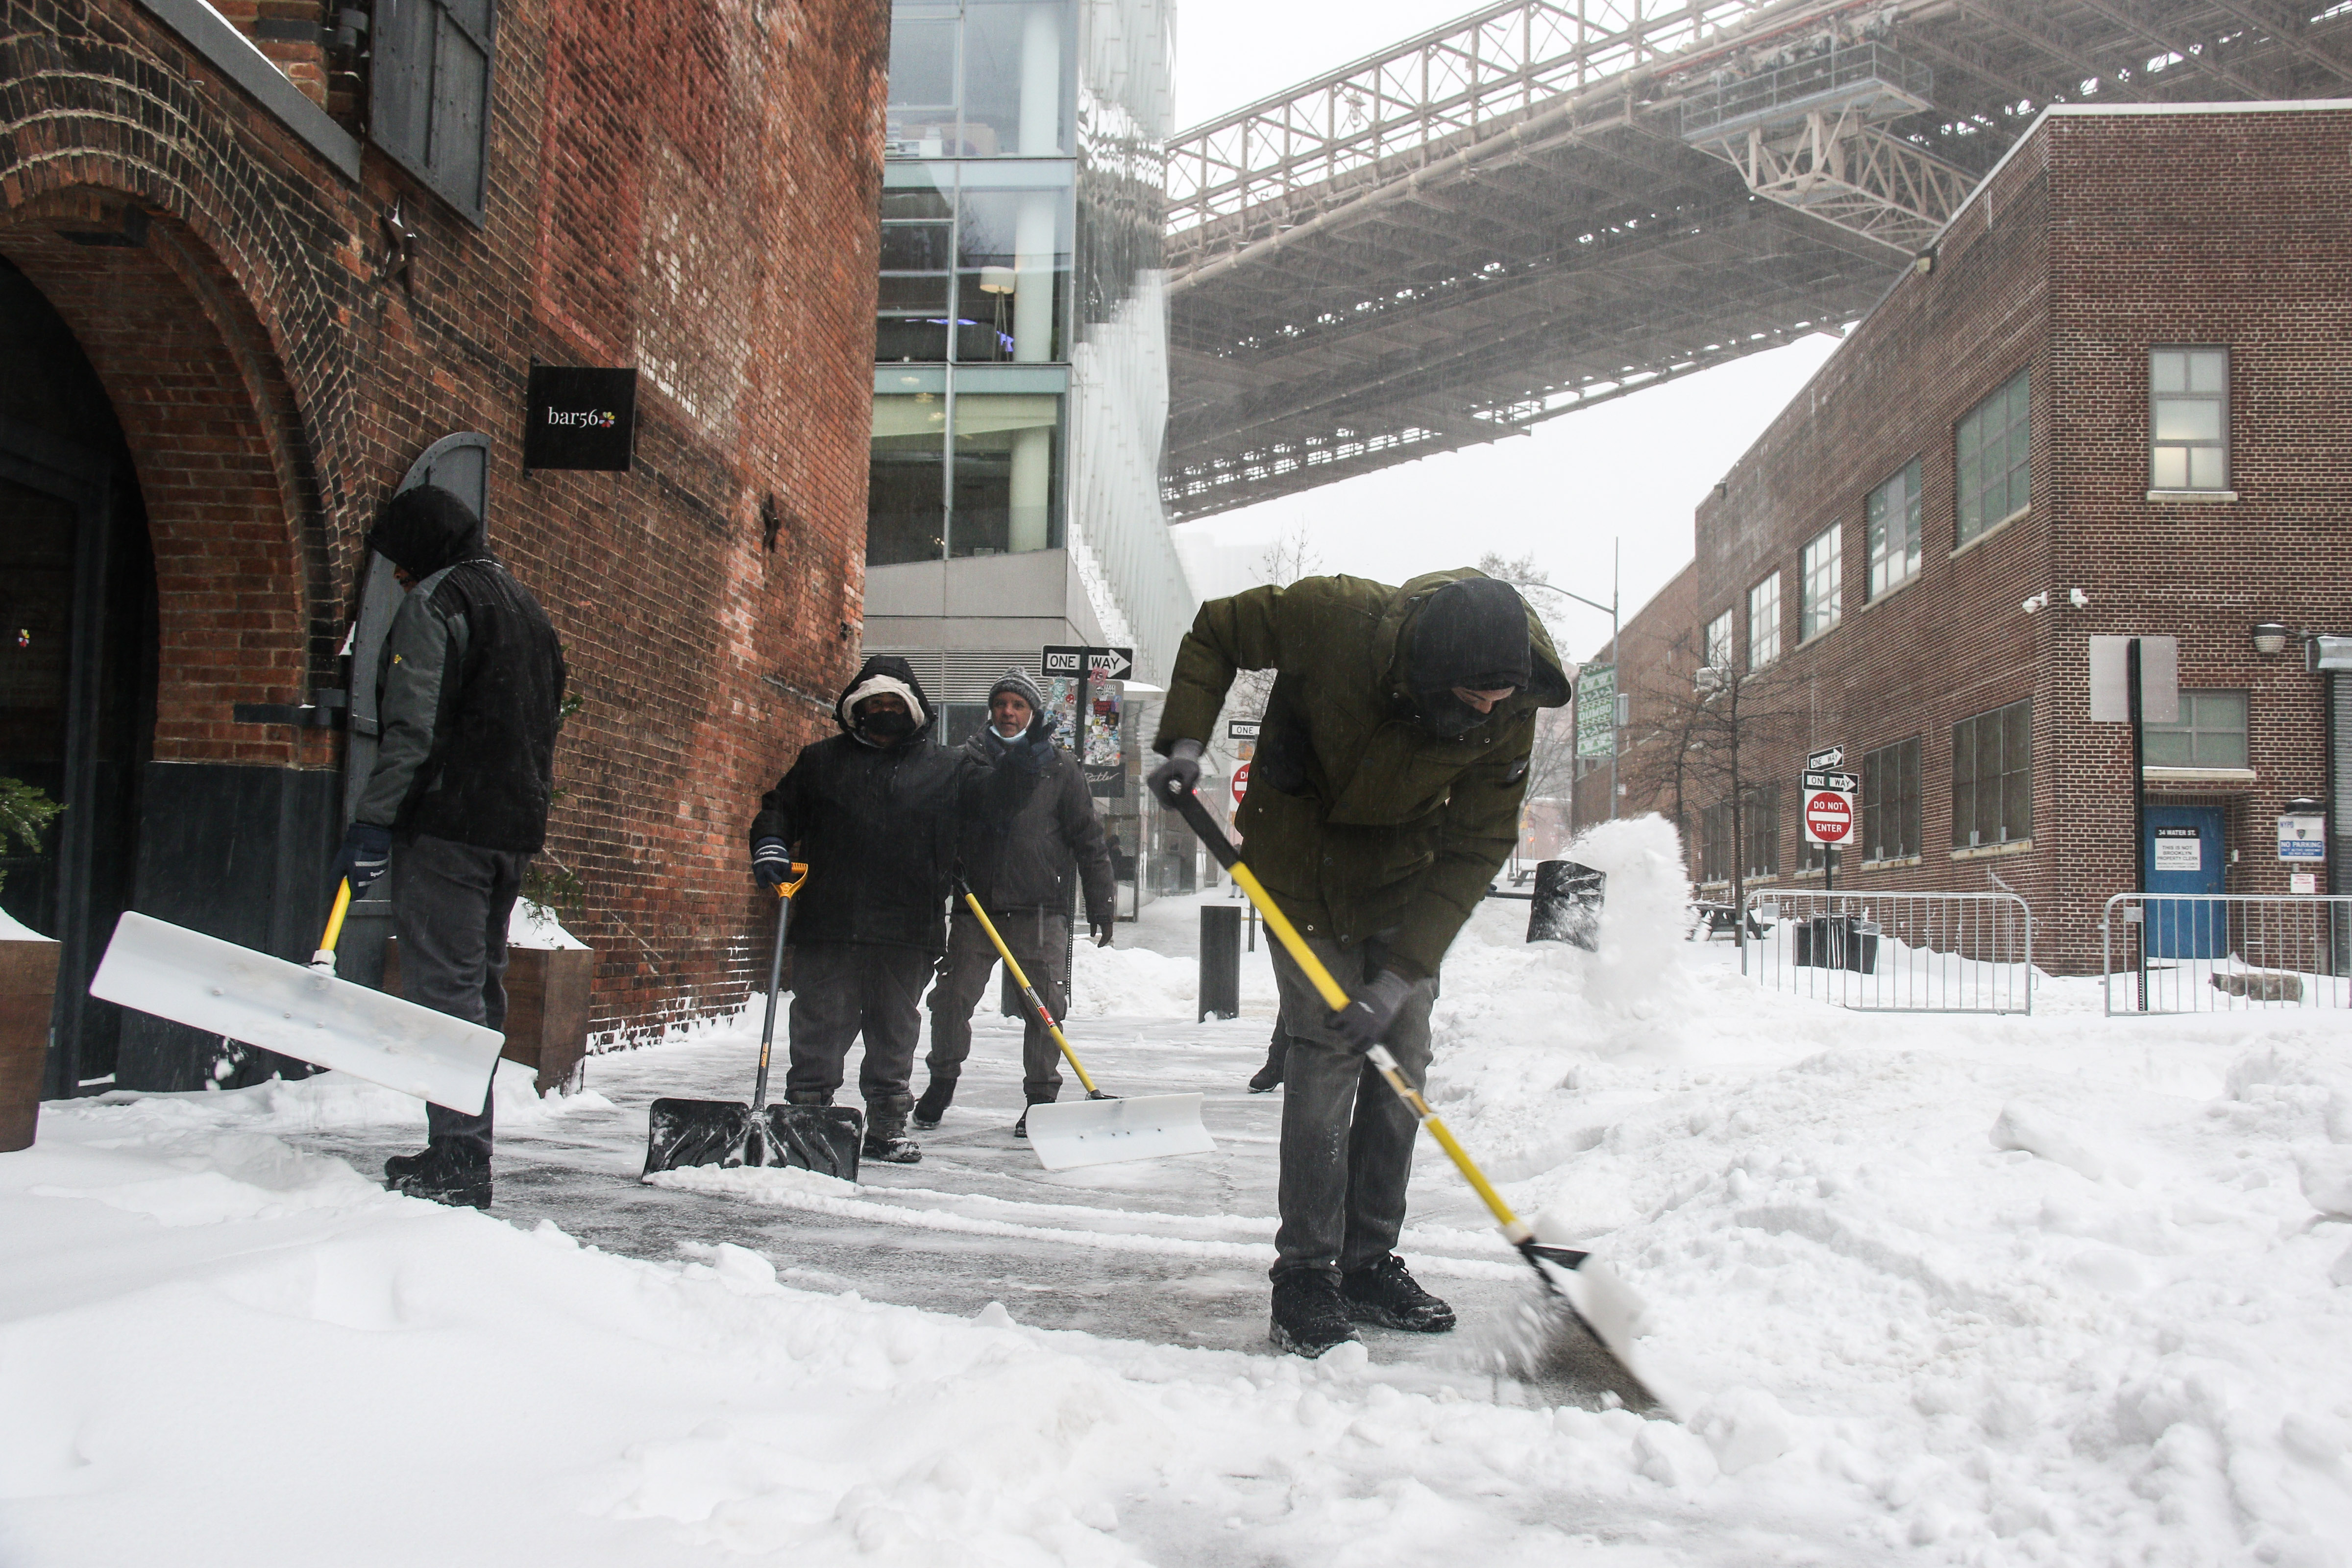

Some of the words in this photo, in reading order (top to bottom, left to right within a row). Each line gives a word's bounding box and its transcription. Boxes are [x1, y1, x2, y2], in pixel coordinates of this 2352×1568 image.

[548, 406, 598, 428] bar56
[1050, 655, 1076, 668] ONE
[1091, 657, 1120, 669] WAY
[1579, 704, 1612, 721] DUMBO
[1812, 758, 1822, 767] ONE
[1828, 753, 1838, 762] WAY
[1835, 779, 1850, 787] WAY
[1813, 801, 1825, 809] DO
[1827, 801, 1844, 810] NOT
[1816, 823, 1842, 833] ENTER
